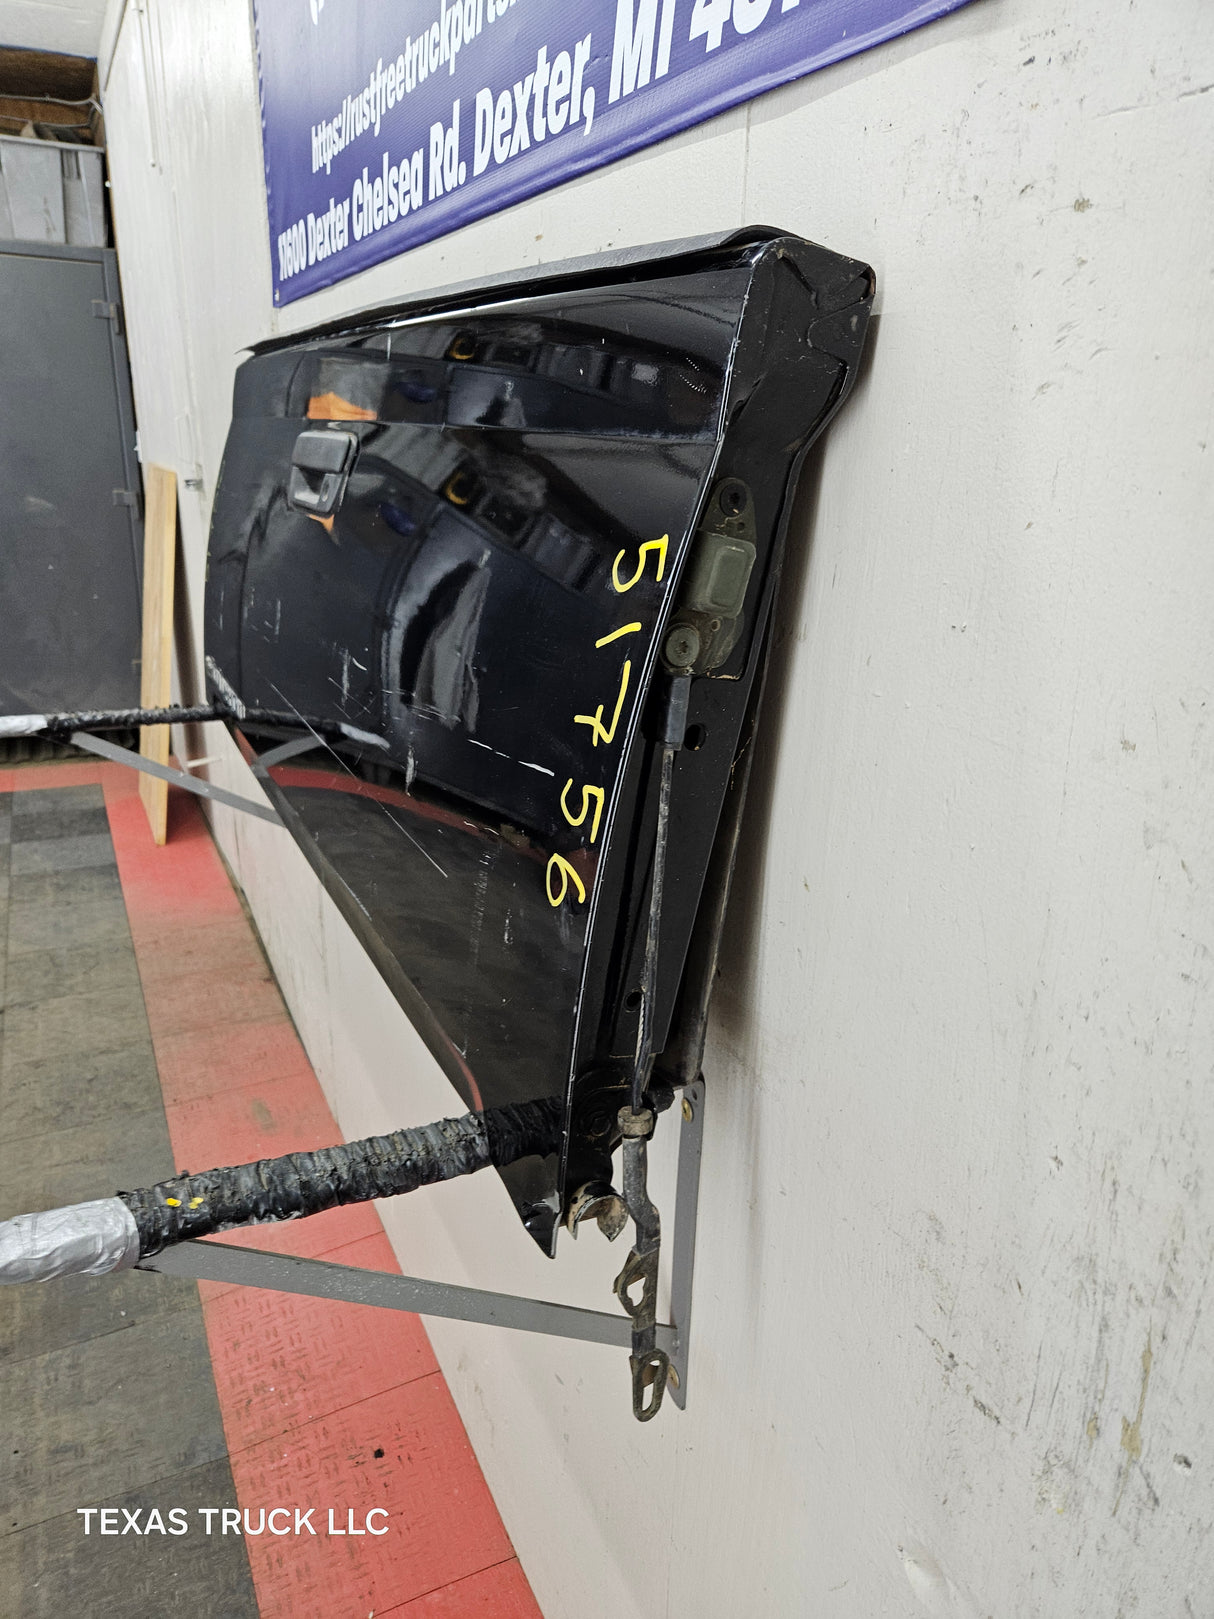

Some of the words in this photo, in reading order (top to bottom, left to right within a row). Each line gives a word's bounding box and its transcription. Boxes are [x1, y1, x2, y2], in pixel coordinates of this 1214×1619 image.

[306, 197, 350, 266] Dexter
[352, 147, 424, 241] Chelsea
[428, 99, 466, 201] Rd.
[473, 32, 596, 177] Dexter,
[608, 0, 677, 104] MI
[545, 533, 669, 908] 51756
